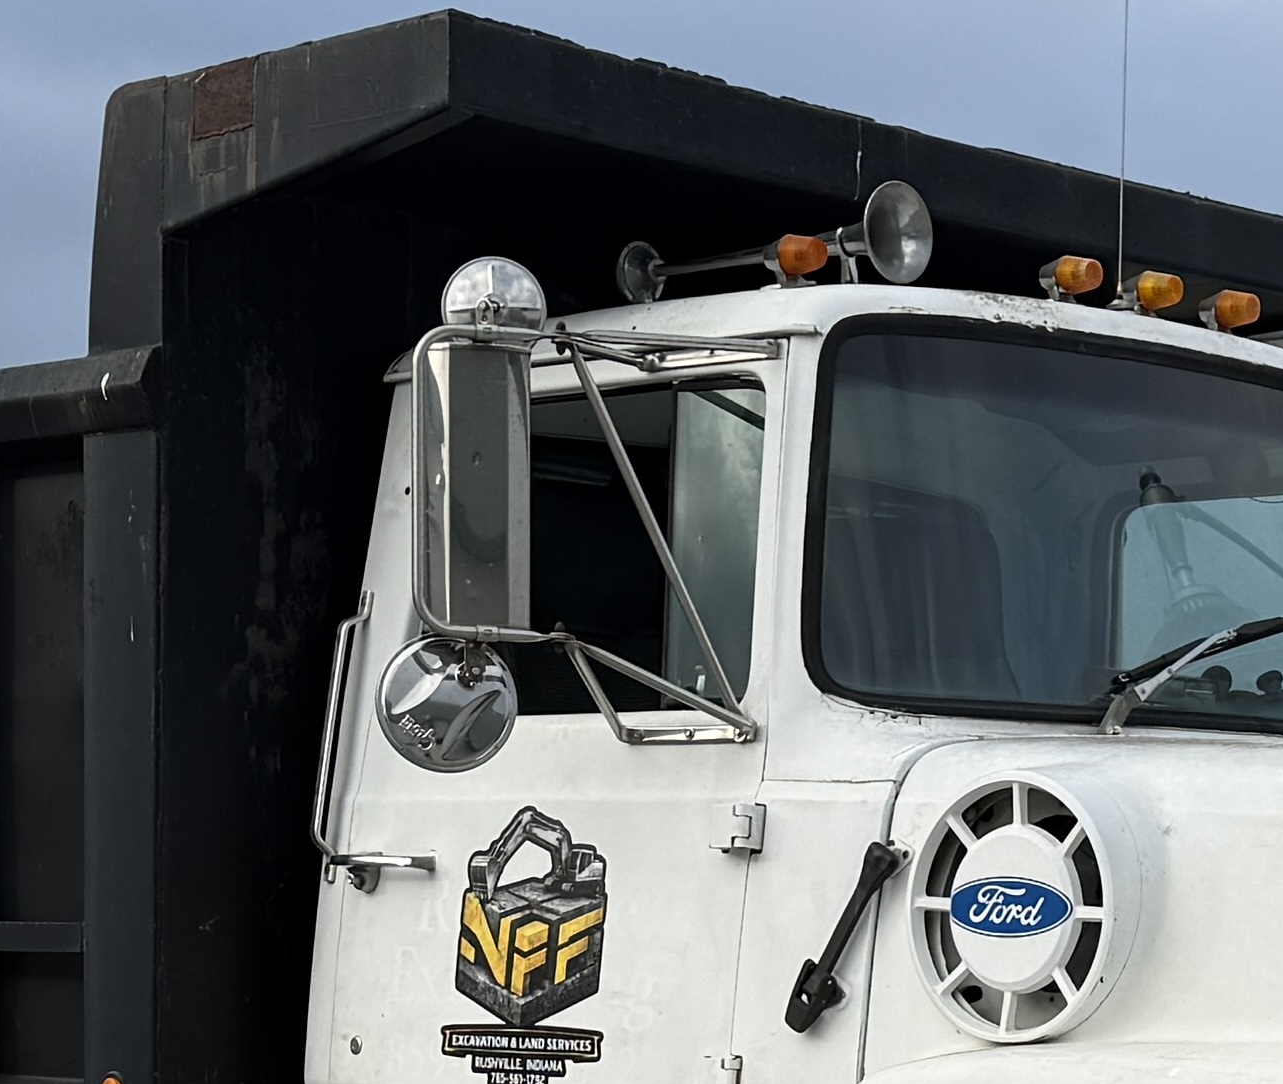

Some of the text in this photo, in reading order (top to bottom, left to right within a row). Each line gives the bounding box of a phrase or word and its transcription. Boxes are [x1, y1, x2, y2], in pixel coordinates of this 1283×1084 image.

[969, 885, 1045, 926] Ford
[452, 1034, 592, 1052] EXCAVATION & LAND SERVICES
[526, 1058, 563, 1073] INDIANA
